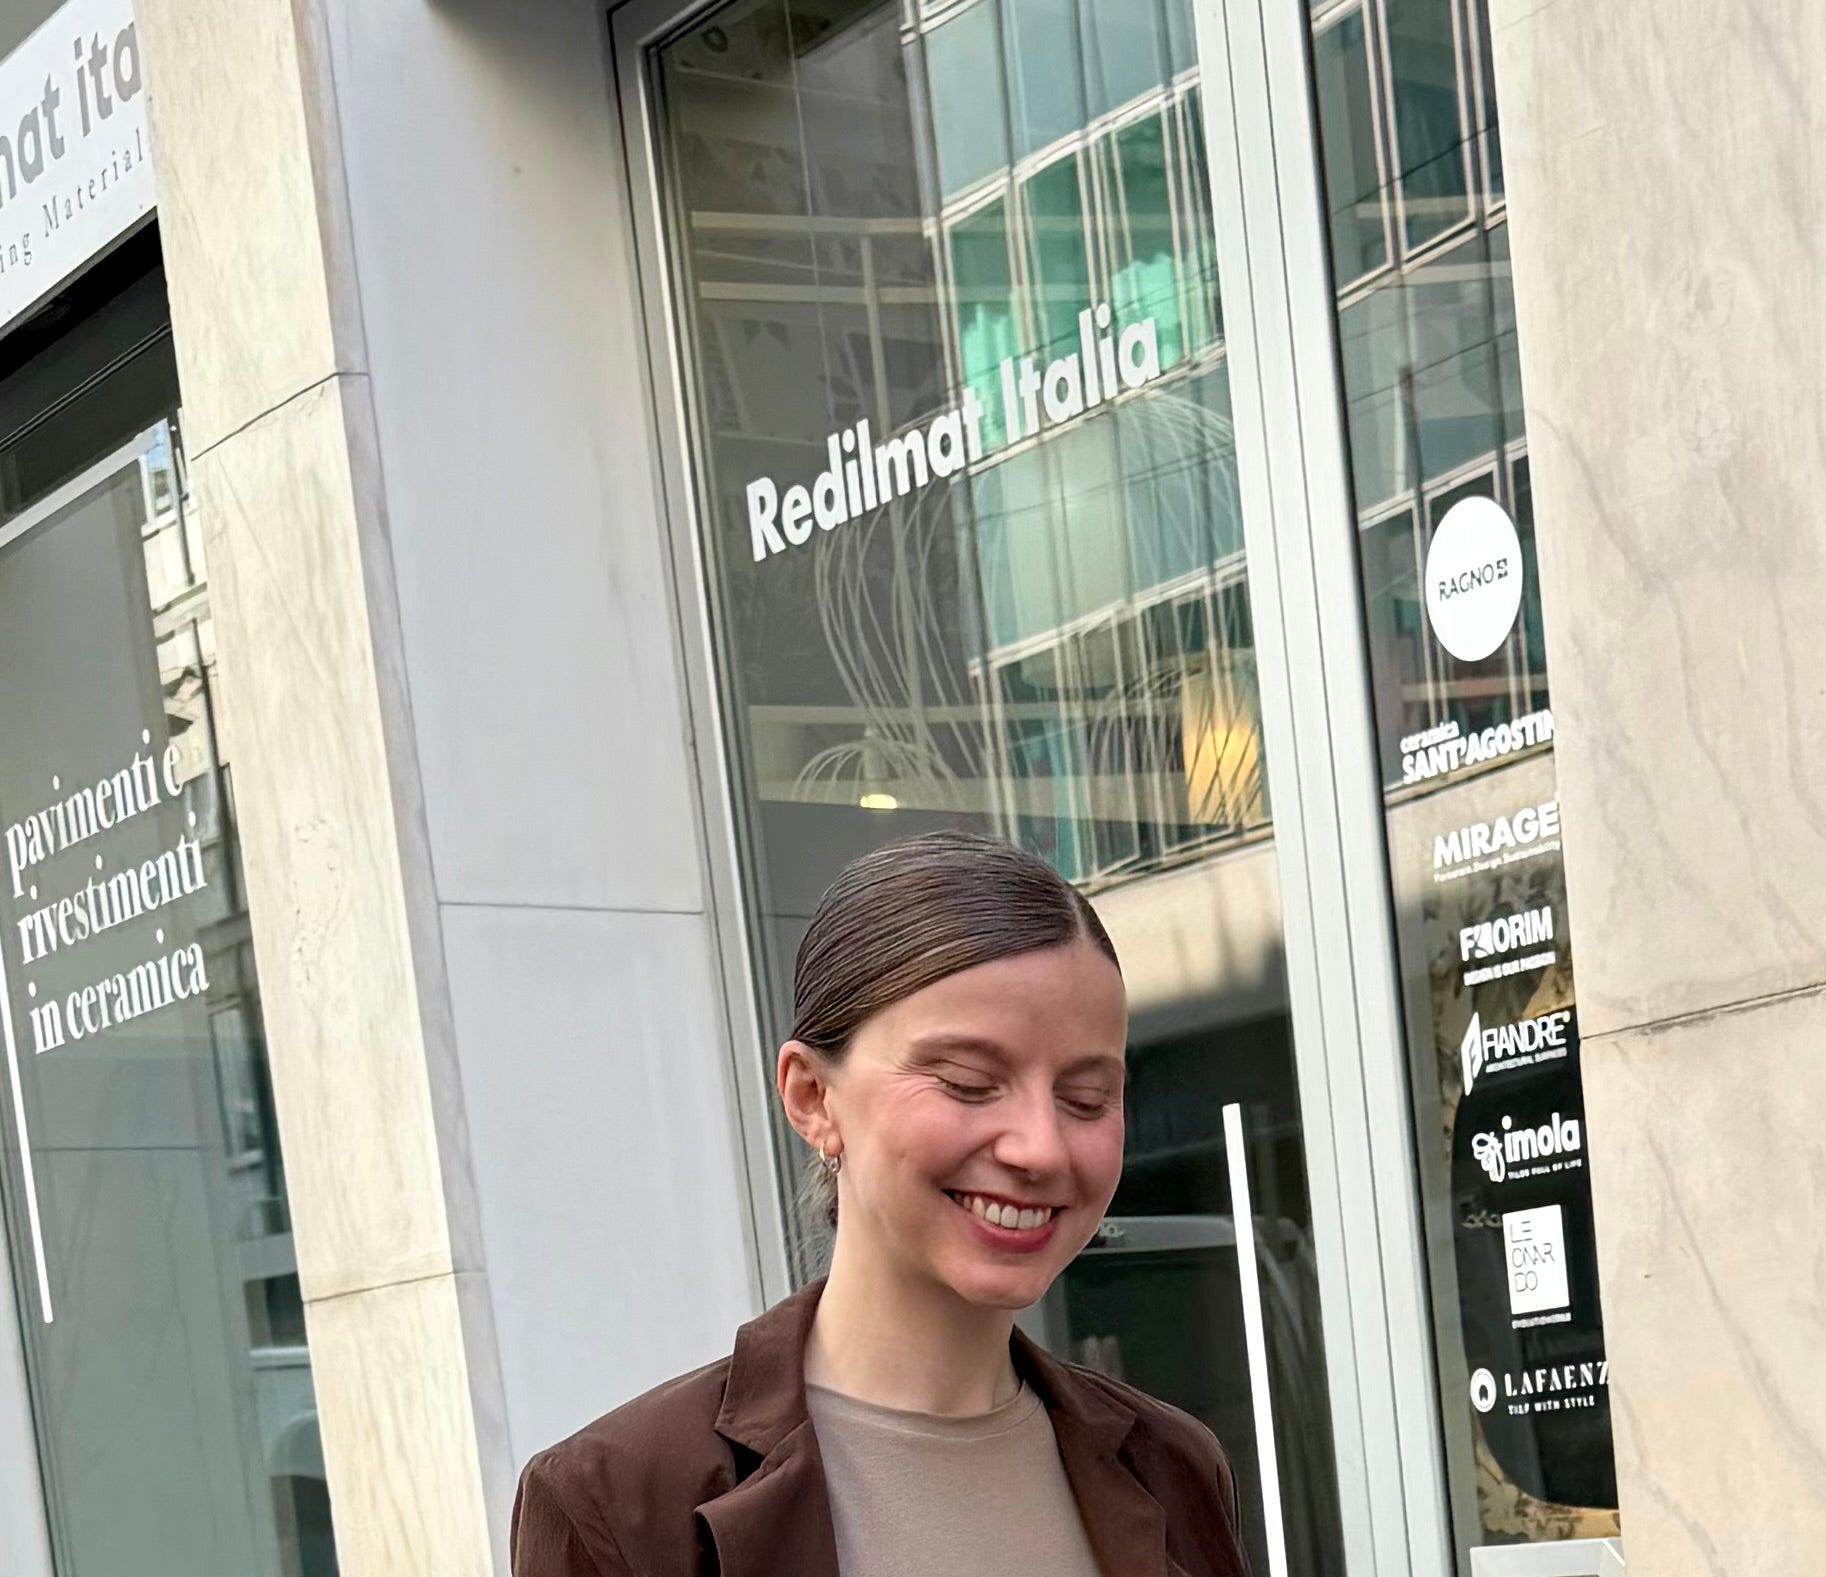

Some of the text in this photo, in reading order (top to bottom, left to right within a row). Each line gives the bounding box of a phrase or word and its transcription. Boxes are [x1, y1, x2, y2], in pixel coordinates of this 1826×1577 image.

[745, 303, 1162, 562] Redilmat Italia
[1438, 563, 1494, 602] RAGNO
[5, 729, 182, 899] pavimenti e
[1433, 800, 1560, 869] MIRAGE
[16, 811, 208, 966] rivestimenti
[28, 929, 210, 1056] in ceramica
[1502, 1112, 1581, 1163] imola
